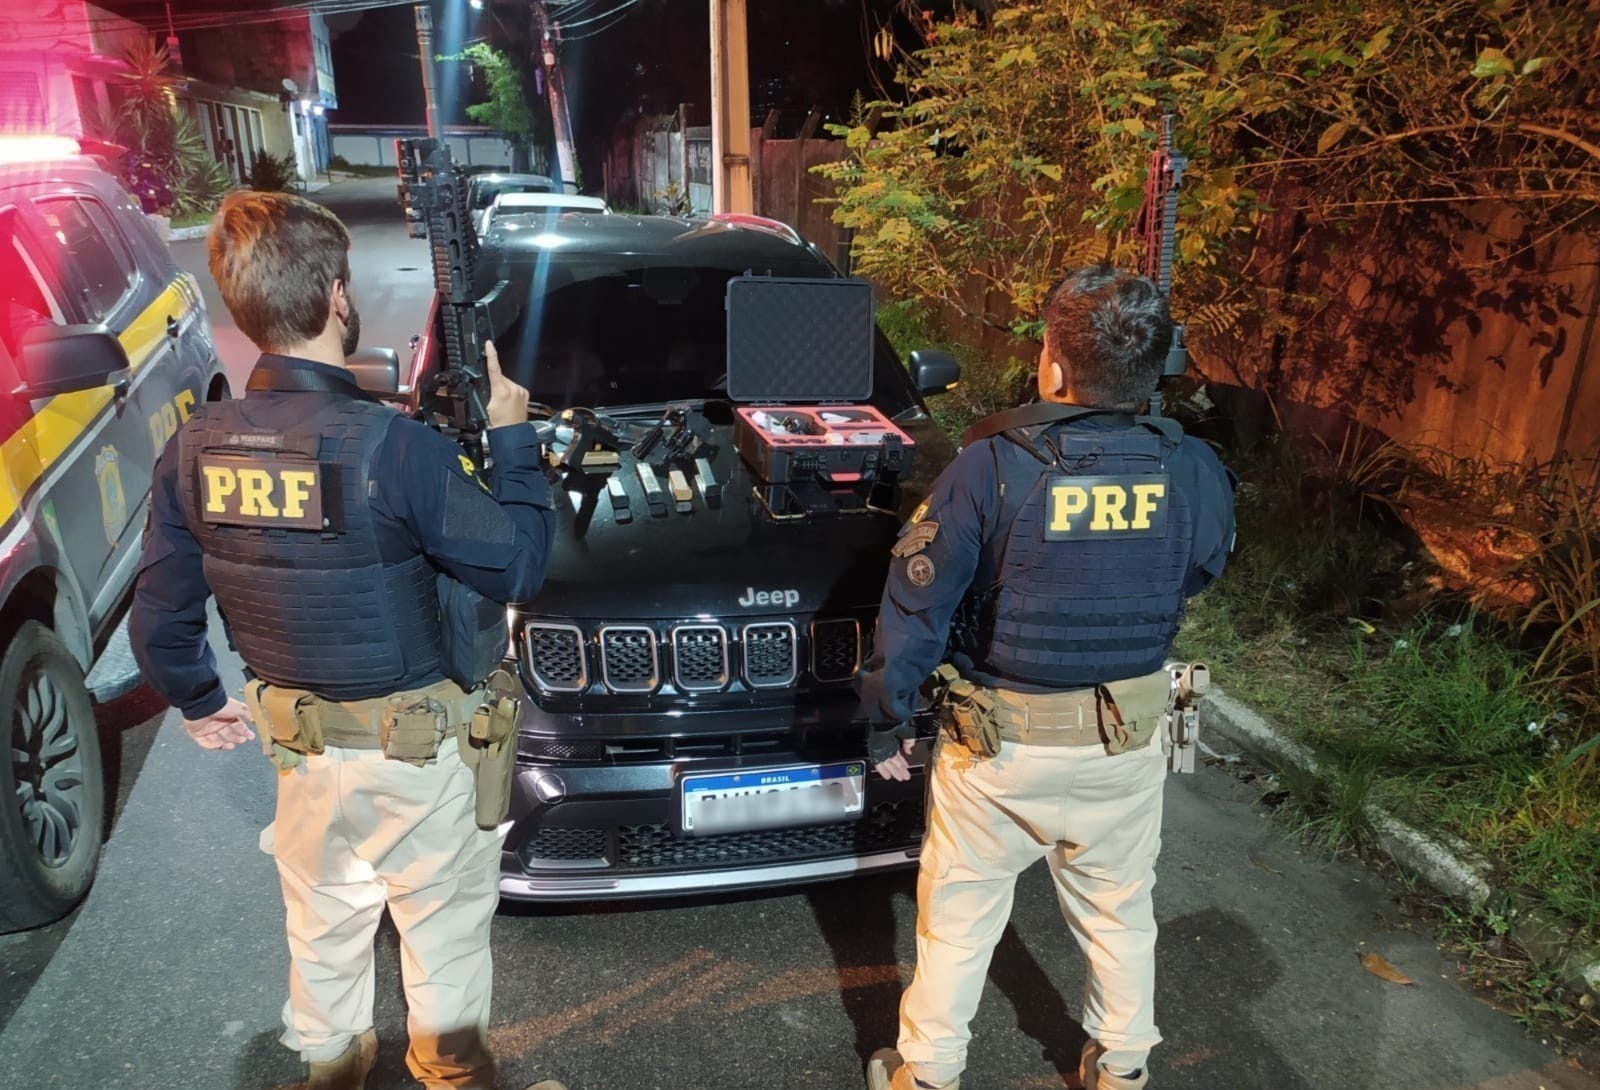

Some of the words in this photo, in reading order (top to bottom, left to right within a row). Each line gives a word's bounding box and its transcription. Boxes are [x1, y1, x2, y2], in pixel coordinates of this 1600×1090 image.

[203, 466, 315, 518] PRF
[1050, 484, 1165, 531] PRF
[738, 587, 800, 608] Jeep
[760, 775, 790, 785] BRASIL
